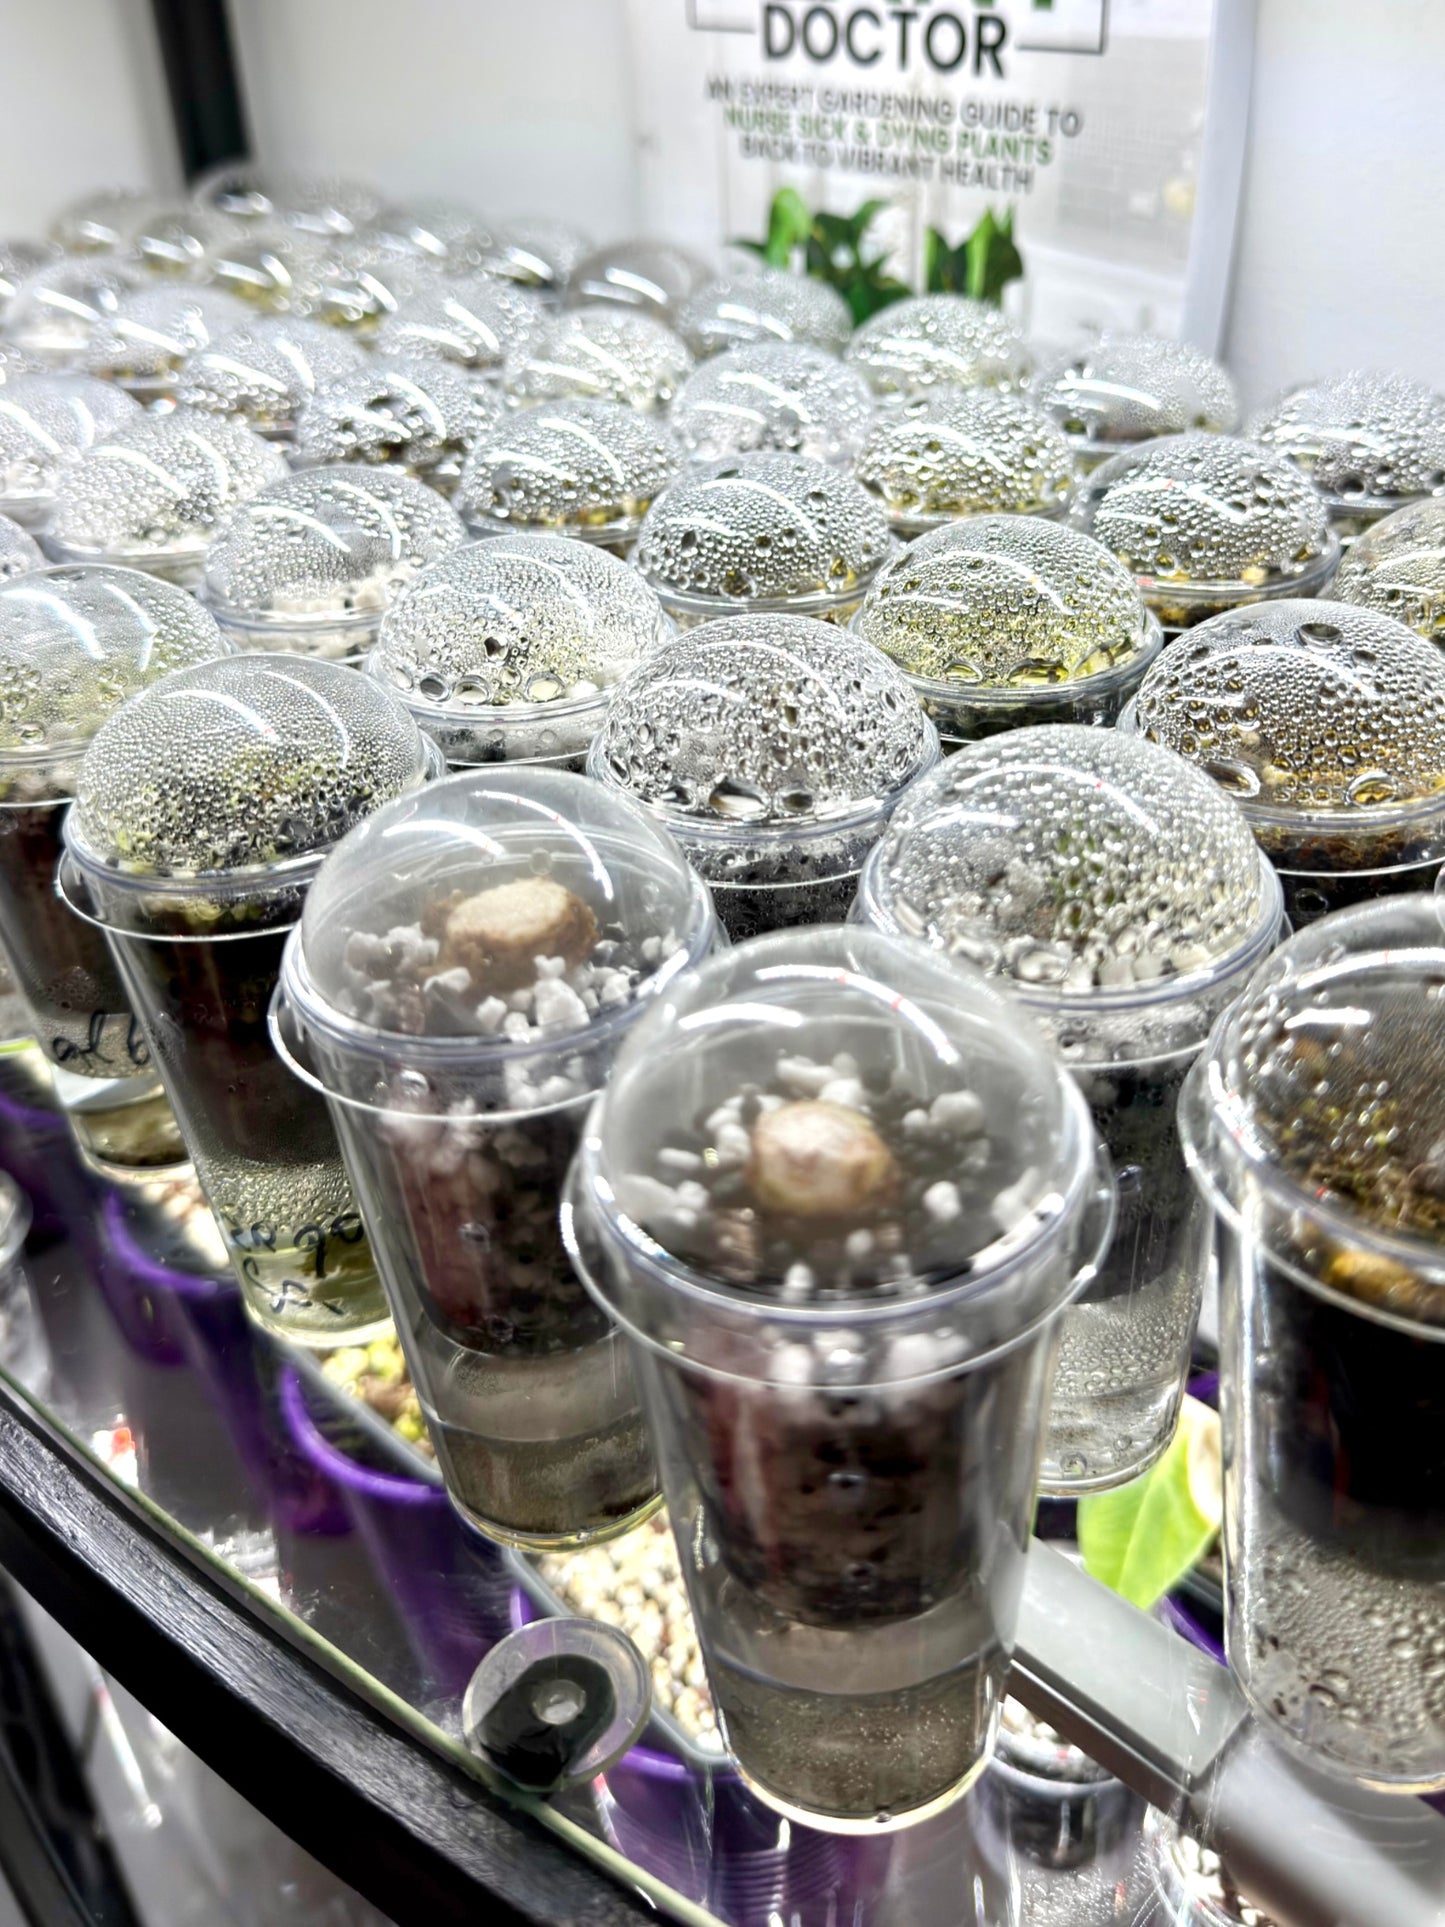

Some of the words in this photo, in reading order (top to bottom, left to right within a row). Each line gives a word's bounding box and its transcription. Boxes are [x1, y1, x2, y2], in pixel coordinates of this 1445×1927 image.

[763, 3, 1007, 78] DOCTOR
[725, 107, 789, 136] NURSE
[797, 113, 845, 140] SICK
[852, 120, 870, 144] &
[875, 121, 951, 153] DYING
[957, 129, 1053, 165] PLANTS
[816, 84, 954, 125] GARDENING
[960, 97, 1034, 133] GUIDE
[1046, 105, 1083, 137] TO
[837, 145, 934, 181] VIBRANT
[938, 159, 1034, 194] HEALTH
